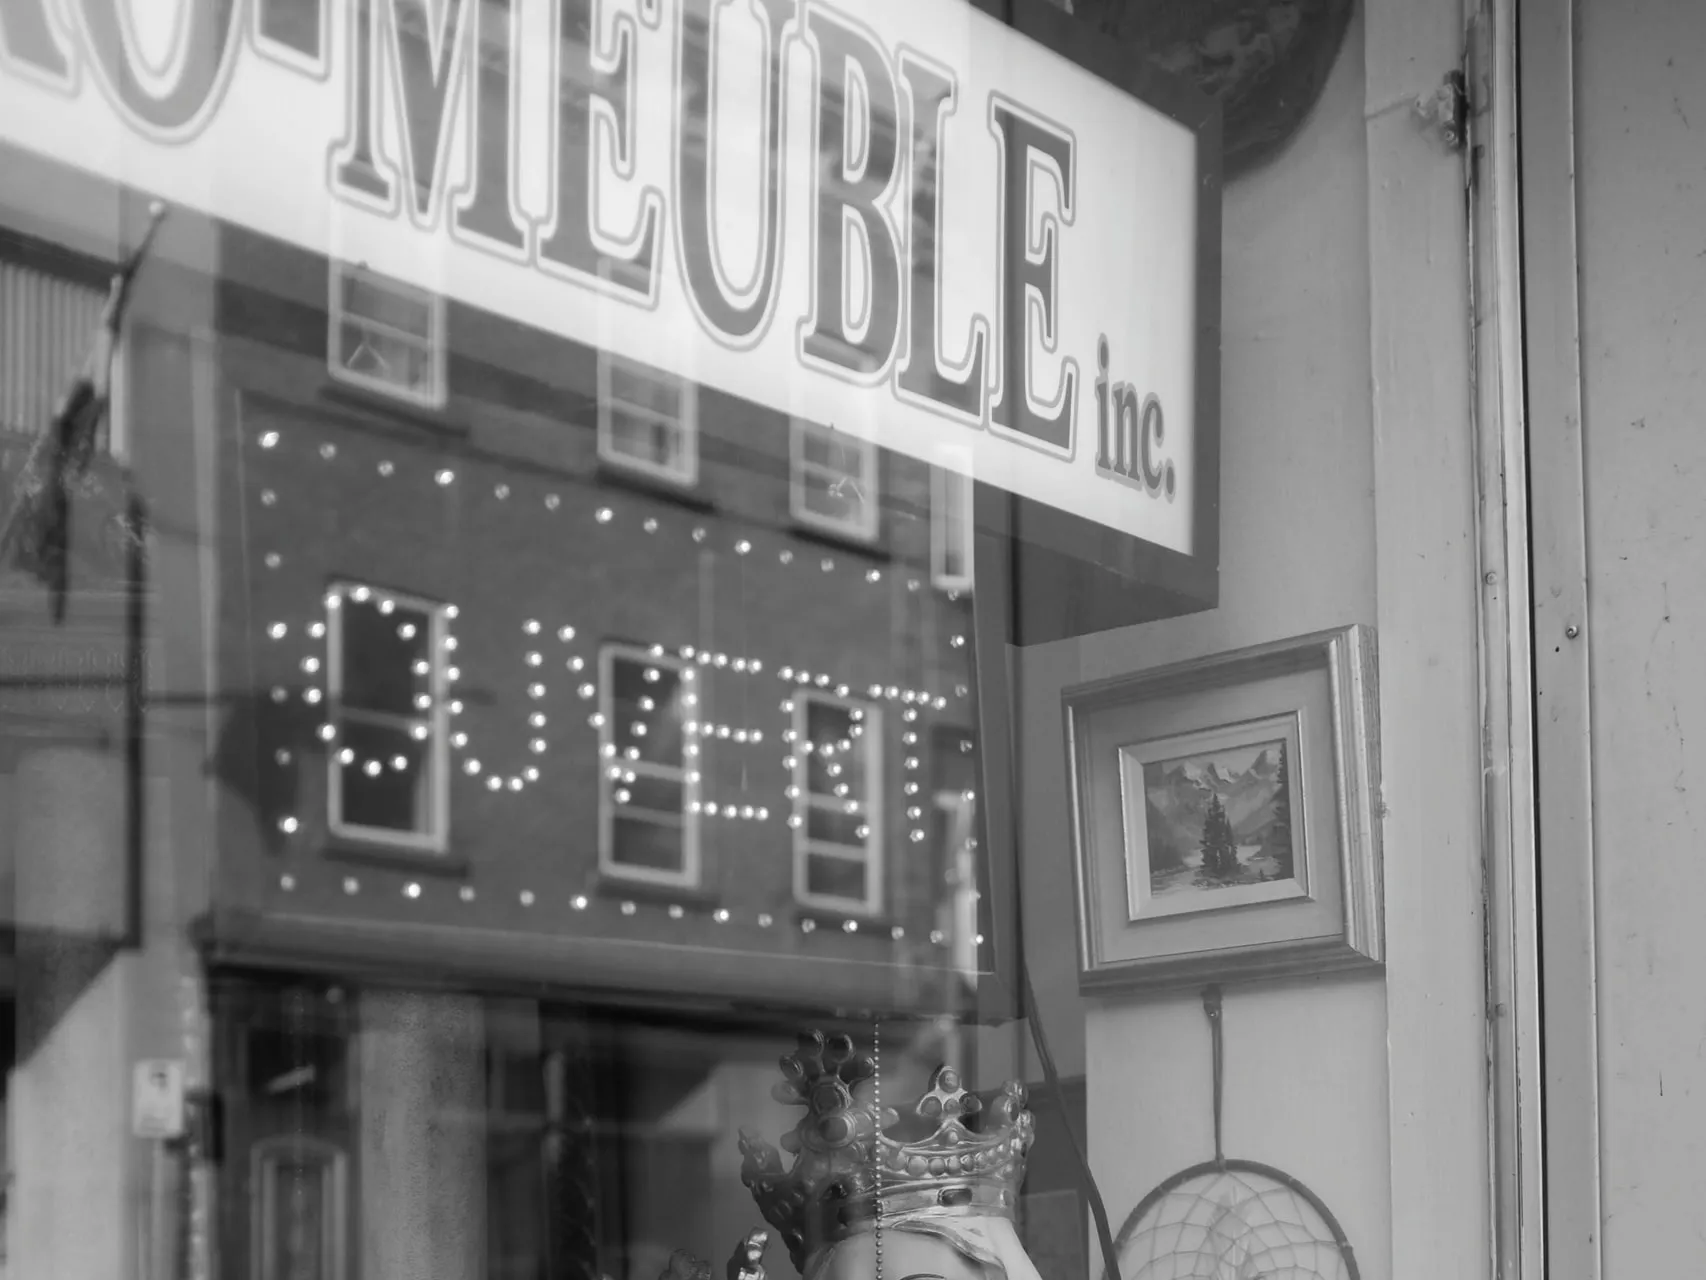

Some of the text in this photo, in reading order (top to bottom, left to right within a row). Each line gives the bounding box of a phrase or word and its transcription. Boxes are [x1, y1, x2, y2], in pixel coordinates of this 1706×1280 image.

[0, 0, 1176, 502] -MEUBLE inc.
[302, 585, 948, 843] OUVERT
